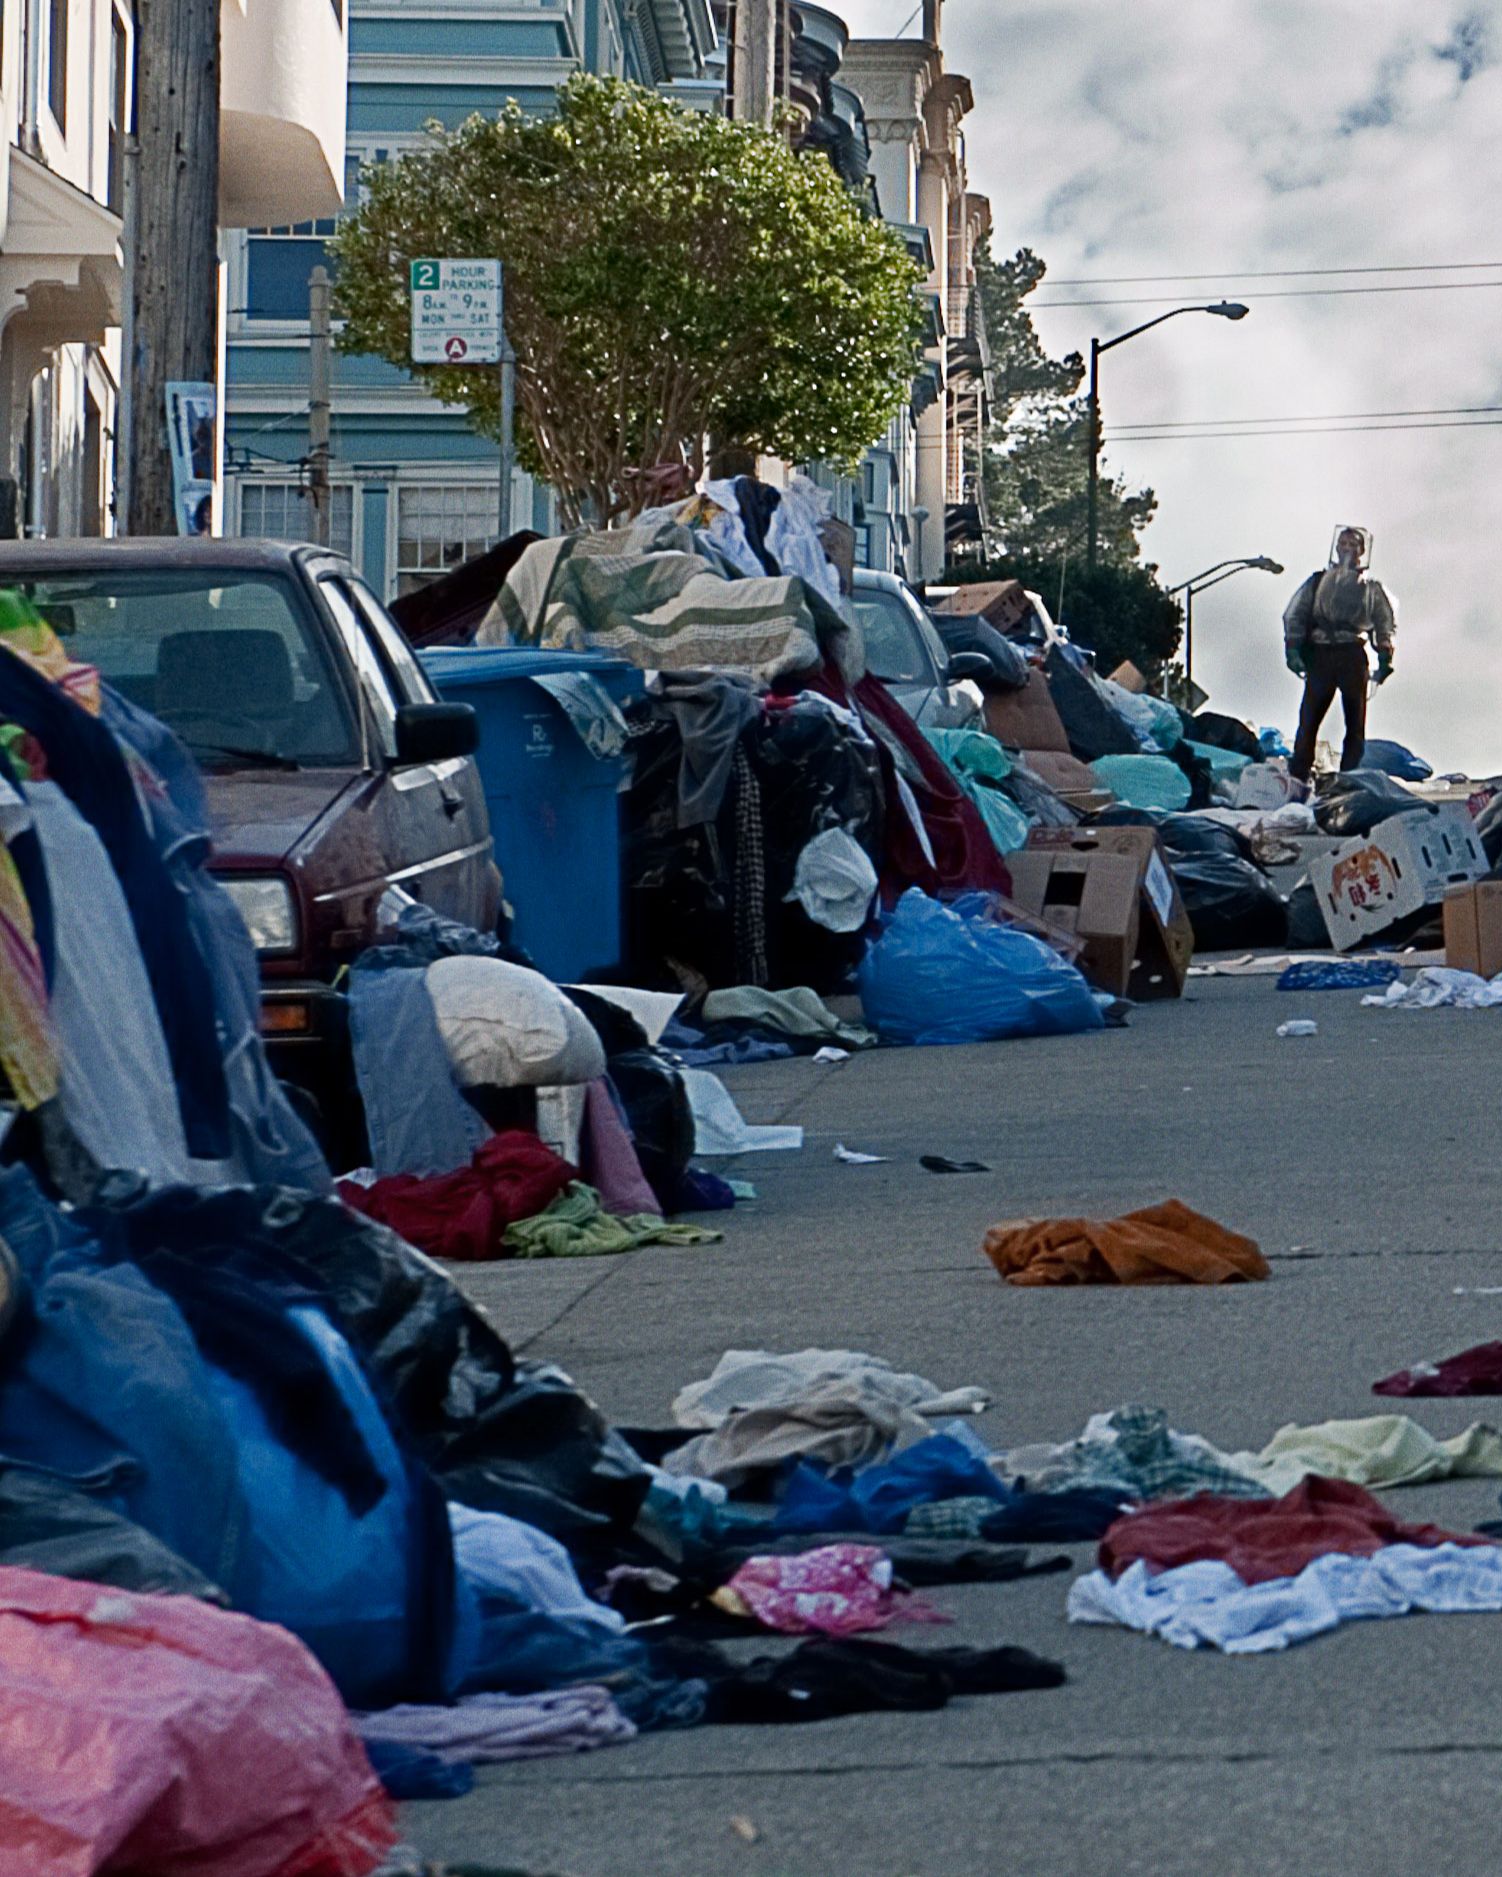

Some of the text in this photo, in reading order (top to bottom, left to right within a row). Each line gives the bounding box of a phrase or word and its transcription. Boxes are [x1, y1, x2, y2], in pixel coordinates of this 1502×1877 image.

[418, 264, 434, 286] 2
[451, 266, 485, 277] HOUR
[442, 279, 495, 290] PARKING
[422, 315, 445, 324] MON
[470, 314, 490, 324] SAT
[449, 340, 463, 355] A
